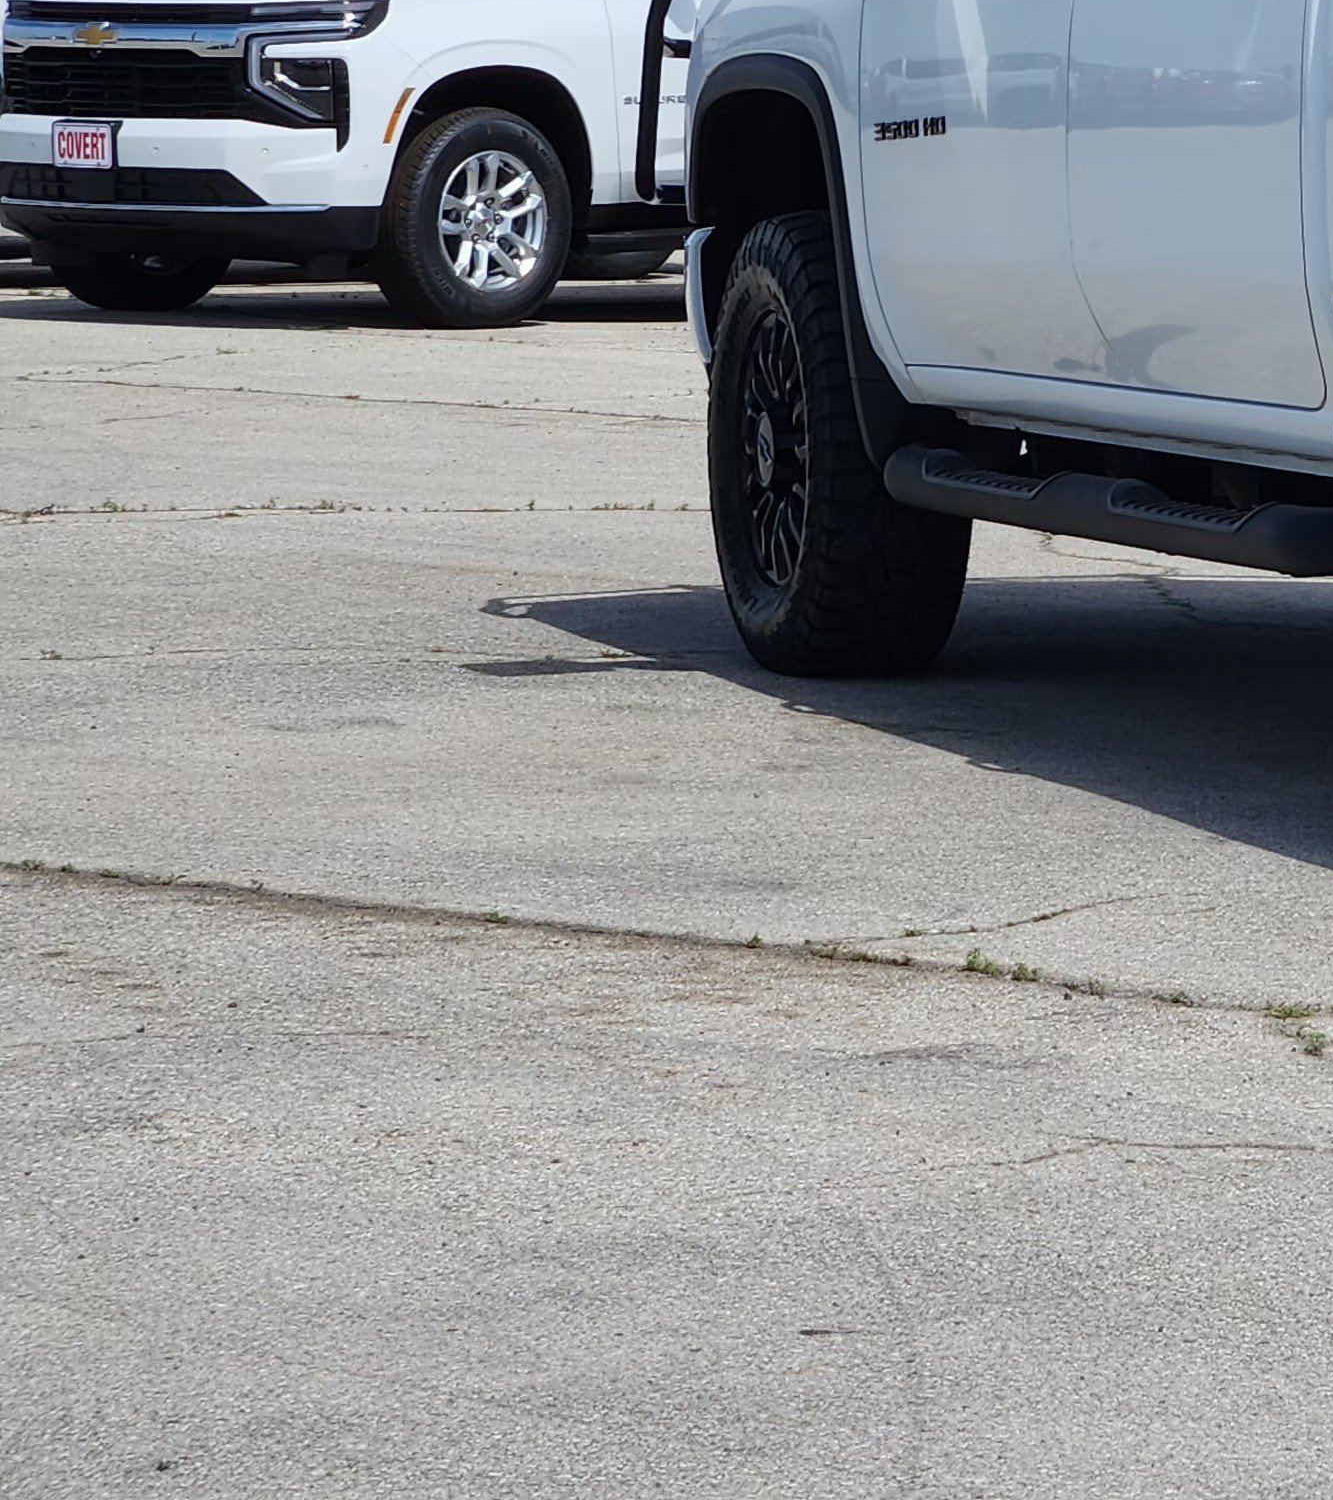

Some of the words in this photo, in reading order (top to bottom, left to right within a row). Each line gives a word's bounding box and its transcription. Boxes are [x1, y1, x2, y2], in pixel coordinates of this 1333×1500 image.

[873, 117, 920, 142] 3500
[922, 115, 947, 137] HD
[57, 130, 106, 161] COVERT
